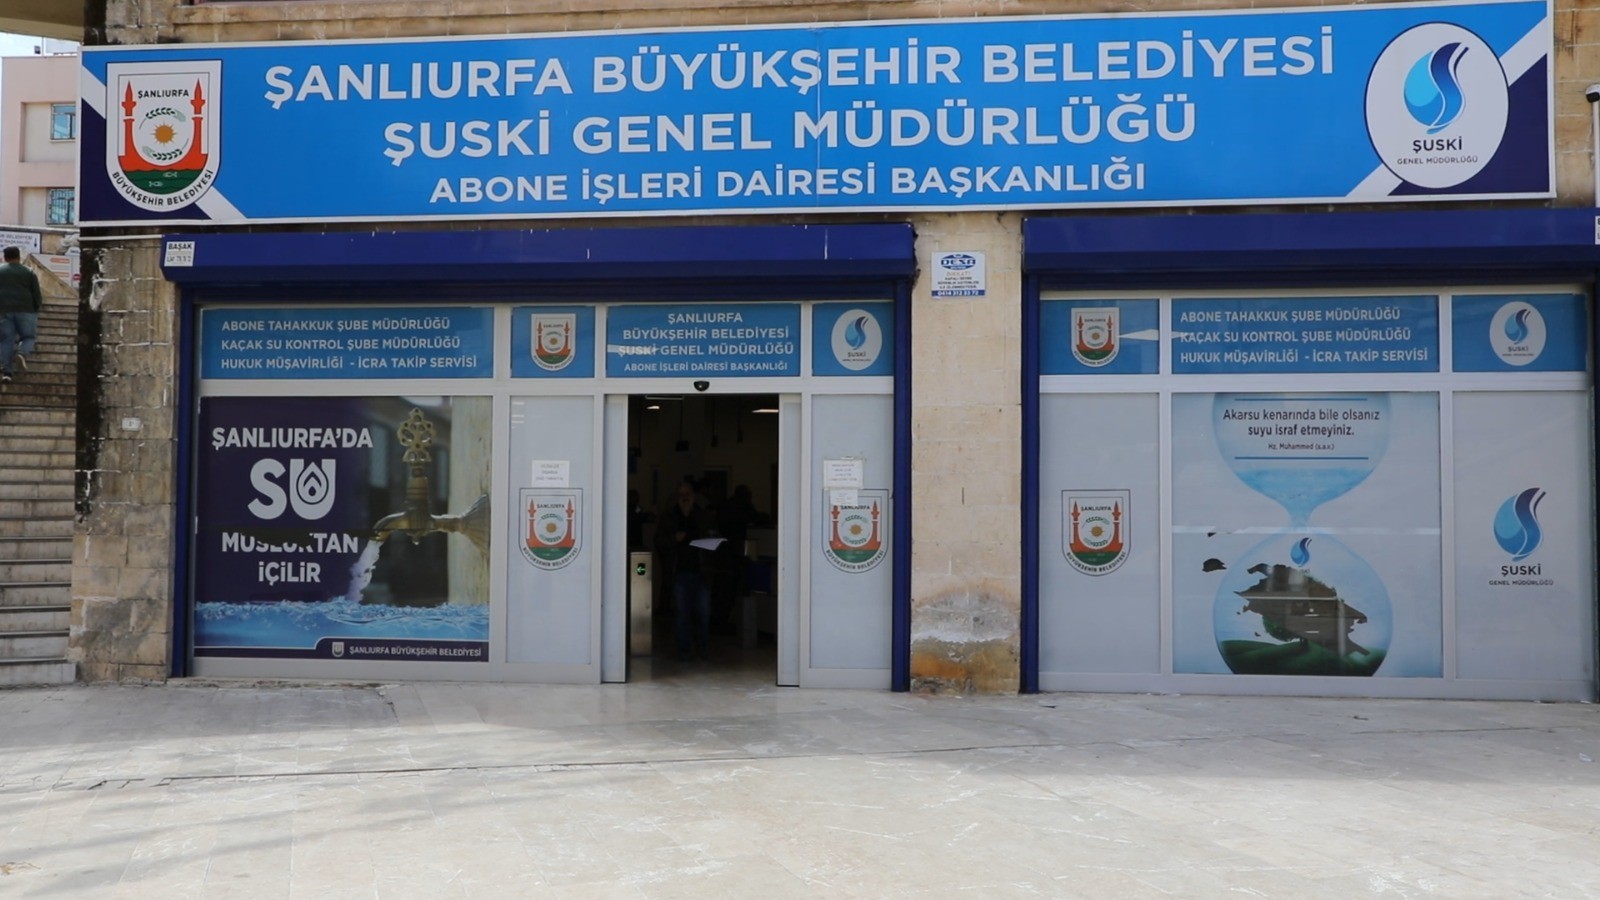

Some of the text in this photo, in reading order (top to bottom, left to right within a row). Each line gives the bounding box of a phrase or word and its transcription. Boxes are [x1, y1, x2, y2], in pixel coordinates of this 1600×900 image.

[264, 25, 1333, 110] ŞANLIURFA BÜYÜKŞEHİR BELEDİYESİ
[138, 89, 189, 98] ŞANLIURFA
[383, 93, 1195, 167] ŞUSKİ GENEL MÜDÜRLÜĞÜ
[1413, 136, 1462, 154] ŞUSKİ
[1426, 155, 1478, 164] MÜDÜRLÜĞÜ
[112, 169, 214, 206] BÜYÜKŞEHİR BELEDİYESİ
[429, 156, 1145, 205] ABONE İŞLERİ DAİRESİ BAŞKANLIĞI
[168, 243, 193, 252] BAŞAK
[668, 312, 742, 324] ŞANLIURFA
[1180, 306, 1400, 323] ABONE TAHAKKUK ŞUBE MÜDÜRLÜĞÜ
[222, 316, 450, 332] ABONE TAHAKKUK ŞUBE MÜDÜRLÜĞÜ
[623, 326, 788, 342] BÜYÜKŞEHİR BELEDİYESİ
[1180, 326, 1410, 344] KAÇAK SU KONTROL ŞUBE MÜDÜRLÜĞÜ
[222, 336, 460, 351] KAÇAK SU KONTROL ŞUBE MÜDÜRLÜĞÜ
[618, 342, 794, 358] ŞUSKİ GENEL MÜDÜRLÜĞÜ
[221, 358, 263, 369] HUKUK
[266, 356, 343, 370] MÜŞAVİRLİĞİ
[358, 356, 387, 368] İCRA
[391, 356, 427, 368] TAKİP
[430, 355, 477, 368] SERVİSİ
[1180, 352, 1220, 363] HUKUK
[1224, 348, 1298, 364] MÜŞAVİRLİĞİ
[1312, 348, 1341, 362] İCRA
[1344, 348, 1379, 362] TAKİP
[1382, 347, 1428, 361] SERVİSİ
[624, 360, 788, 374] ABONE İŞLERİ DAİRESİ BAŞKANLIĞI
[1223, 409, 1380, 420] Akarsu kenarında bile olsanız
[212, 427, 373, 450] ŞANLIURFA'DA
[1248, 424, 1354, 438] suyu israf etmeyiniz.
[1280, 442, 1314, 450] Muhammed
[247, 458, 336, 520] SU
[258, 561, 321, 586] İÇİLİR
[1501, 563, 1541, 577] ŞUSKİ
[350, 646, 482, 656] ŞANLIURFA BÜYÜKŞEHİR BELEDİYESİ
